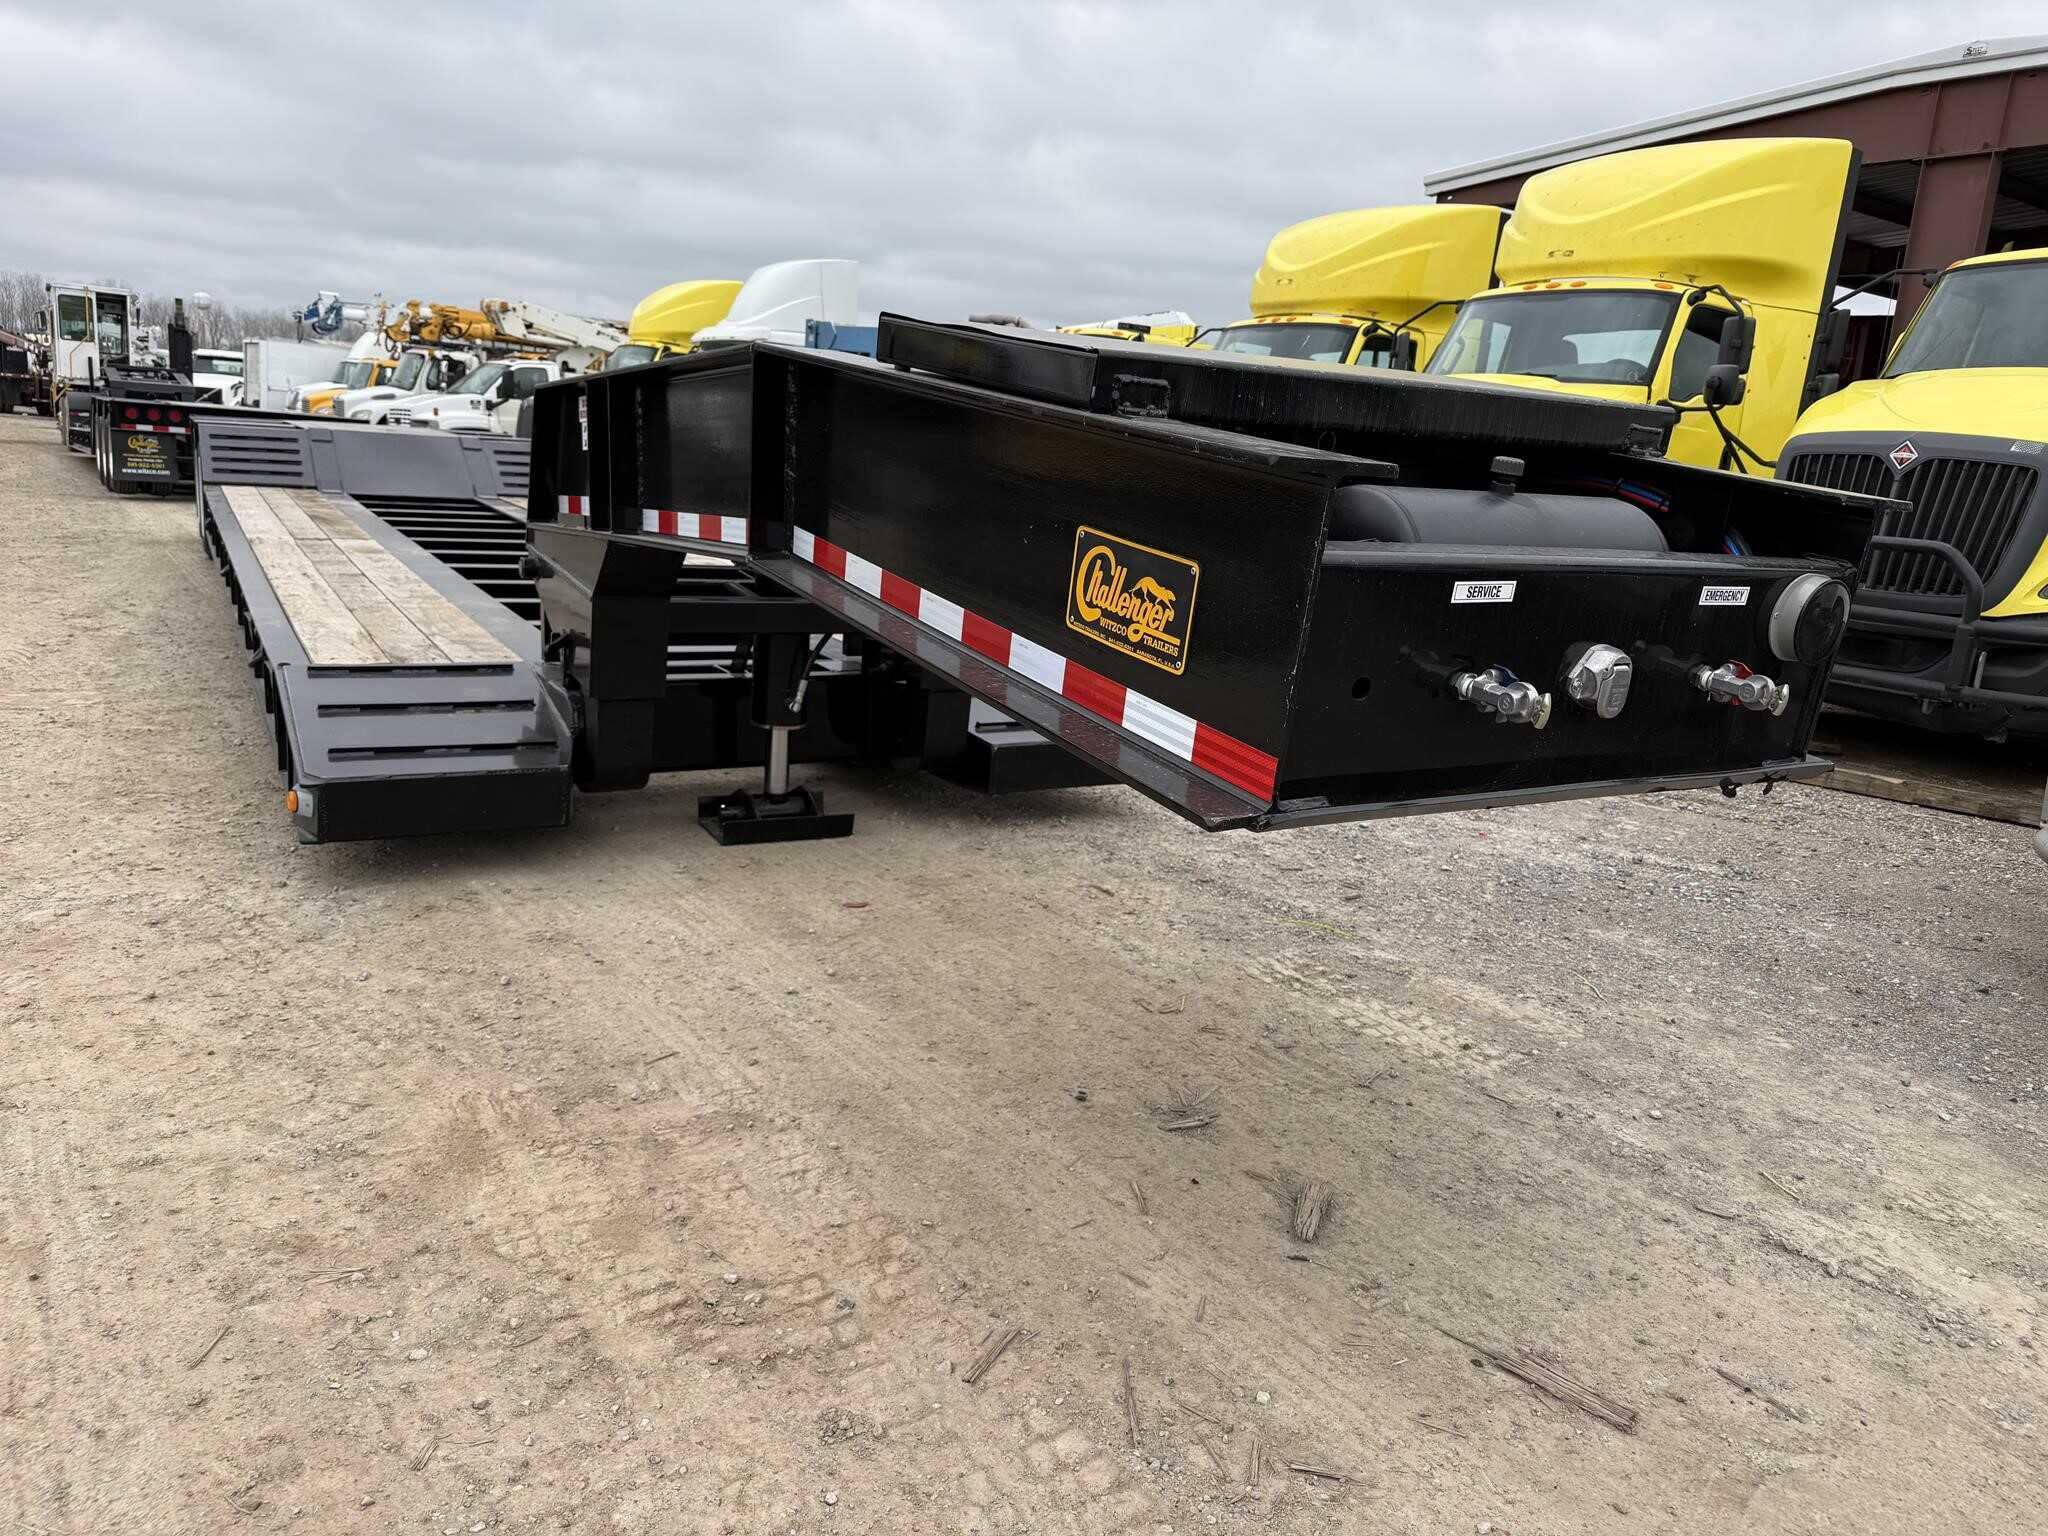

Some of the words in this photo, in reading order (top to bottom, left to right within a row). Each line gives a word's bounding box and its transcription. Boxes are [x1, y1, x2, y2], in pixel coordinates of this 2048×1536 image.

[1076, 546, 1180, 645] Challenger
[1466, 585, 1502, 599] SERVICE
[1705, 590, 1745, 602] EMERGENCY
[1100, 616, 1127, 636] WITZCO
[1143, 634, 1179, 657] TRAILERS
